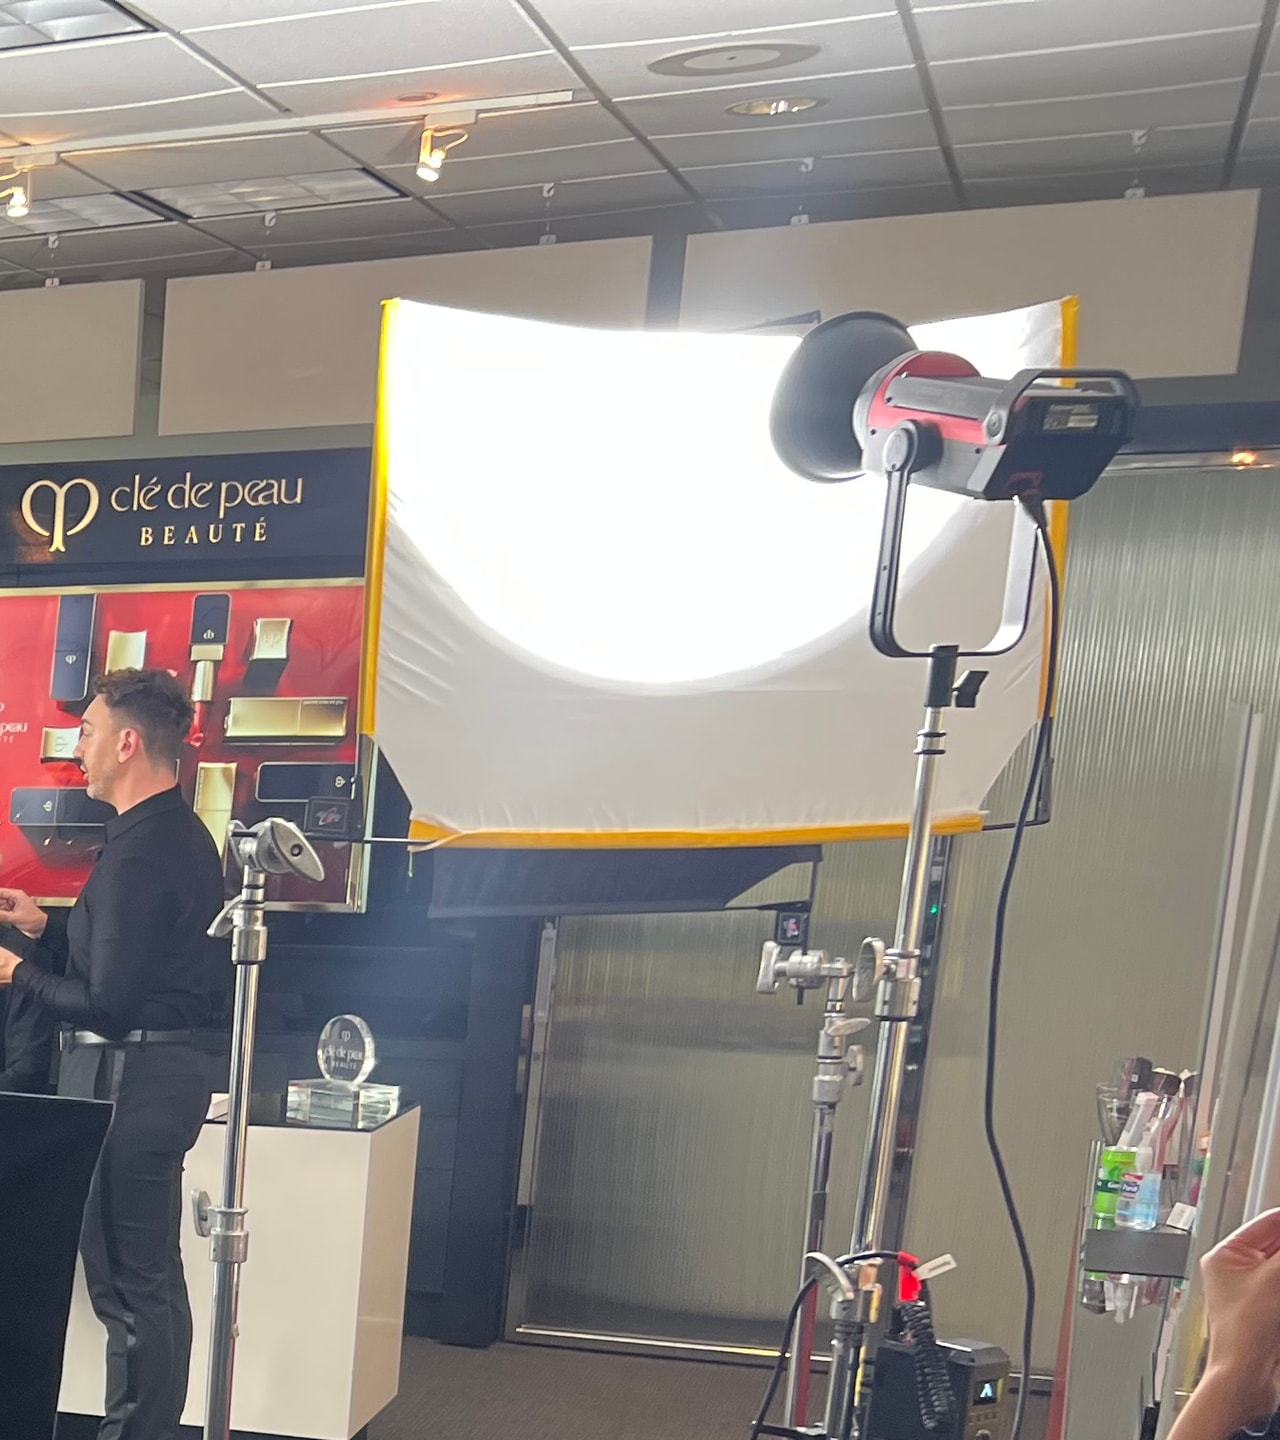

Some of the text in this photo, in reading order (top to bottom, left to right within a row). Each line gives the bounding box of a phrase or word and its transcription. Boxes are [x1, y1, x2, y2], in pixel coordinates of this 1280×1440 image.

[111, 472, 303, 519] clé de peau
[140, 517, 267, 546] BEAUTÉ
